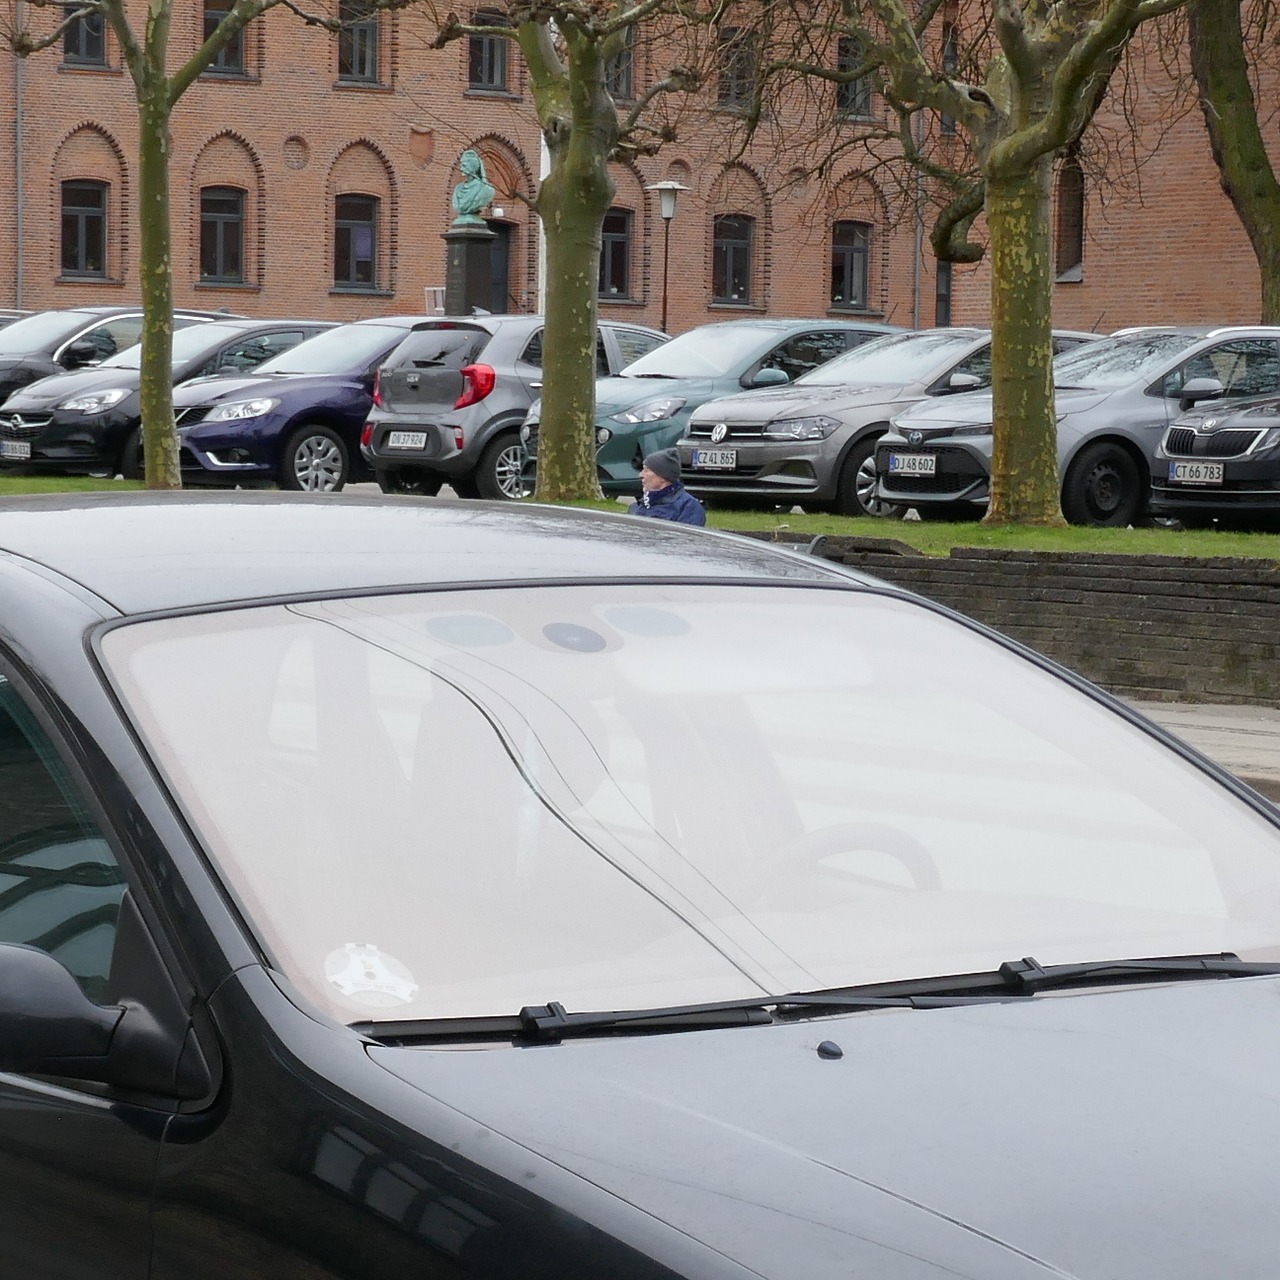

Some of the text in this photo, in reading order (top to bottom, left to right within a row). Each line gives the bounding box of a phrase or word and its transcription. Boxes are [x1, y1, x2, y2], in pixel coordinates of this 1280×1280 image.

[697, 452, 708, 464] CZ
[709, 452, 718, 465] 41
[906, 457, 917, 471] 48
[918, 458, 934, 472] 602
[1175, 464, 1222, 480] CT 66 783
